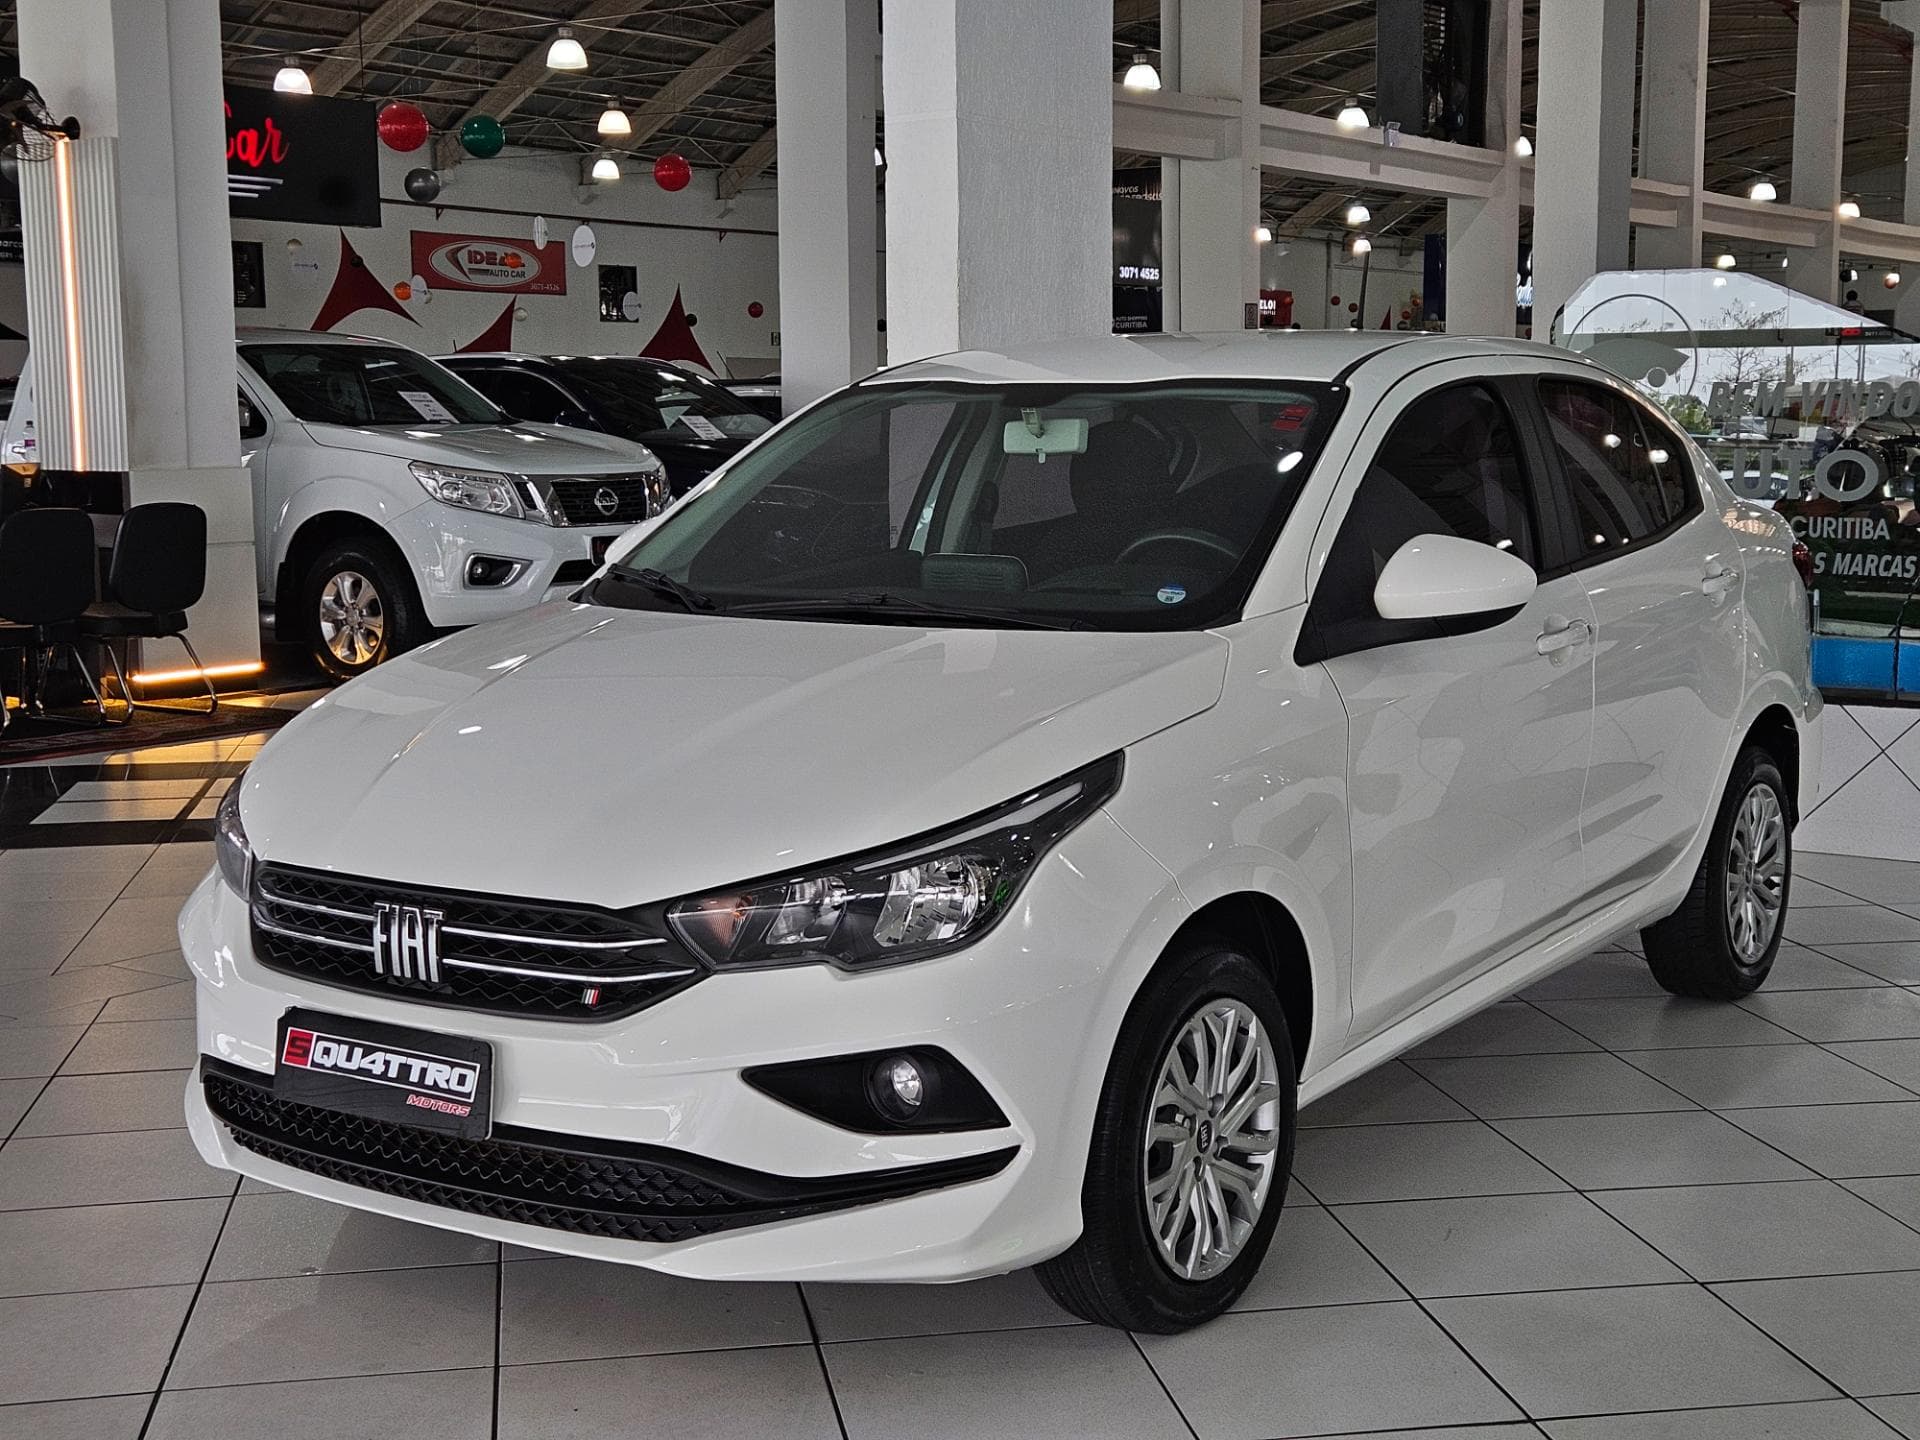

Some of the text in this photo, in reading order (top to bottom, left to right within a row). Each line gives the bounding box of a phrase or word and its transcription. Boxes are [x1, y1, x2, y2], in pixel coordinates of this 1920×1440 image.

[489, 269, 526, 279] AUTO CAR
[1119, 266, 1160, 280] 3071 4525
[1115, 321, 1148, 329] CURITIBA
[1708, 381, 1788, 417] BEM
[1790, 515, 1890, 540] CURITIBA
[1832, 554, 1917, 579] MARCAS
[373, 901, 444, 983] FIAT
[406, 1094, 472, 1118] MOTORS
